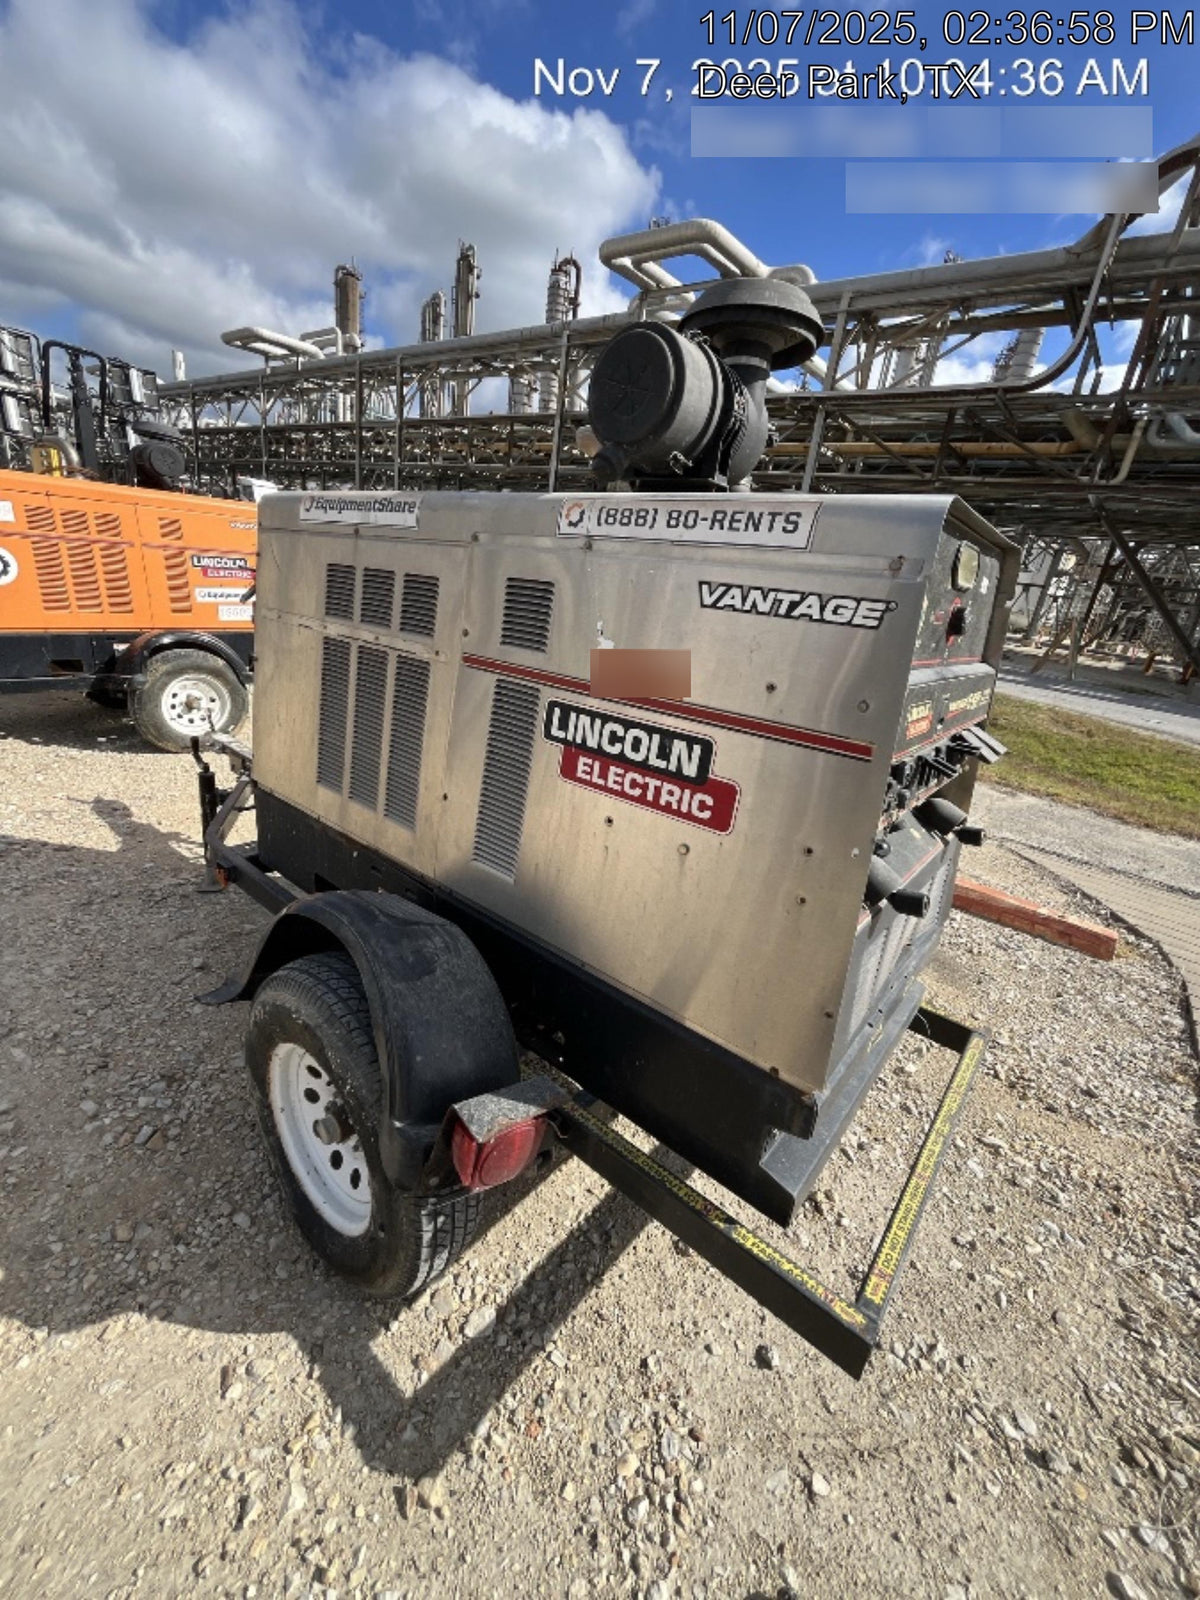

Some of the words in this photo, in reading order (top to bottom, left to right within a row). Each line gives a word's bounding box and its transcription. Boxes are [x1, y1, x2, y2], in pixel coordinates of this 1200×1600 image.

[314, 497, 417, 514] EquipmentShare
[597, 507, 659, 530] (888)
[666, 509, 803, 534] 80-RENTS
[193, 555, 246, 568] LINCOLN
[701, 583, 887, 627] VANTAGE
[550, 707, 702, 778] LINCOLN
[576, 755, 714, 820] ELECTRIC
